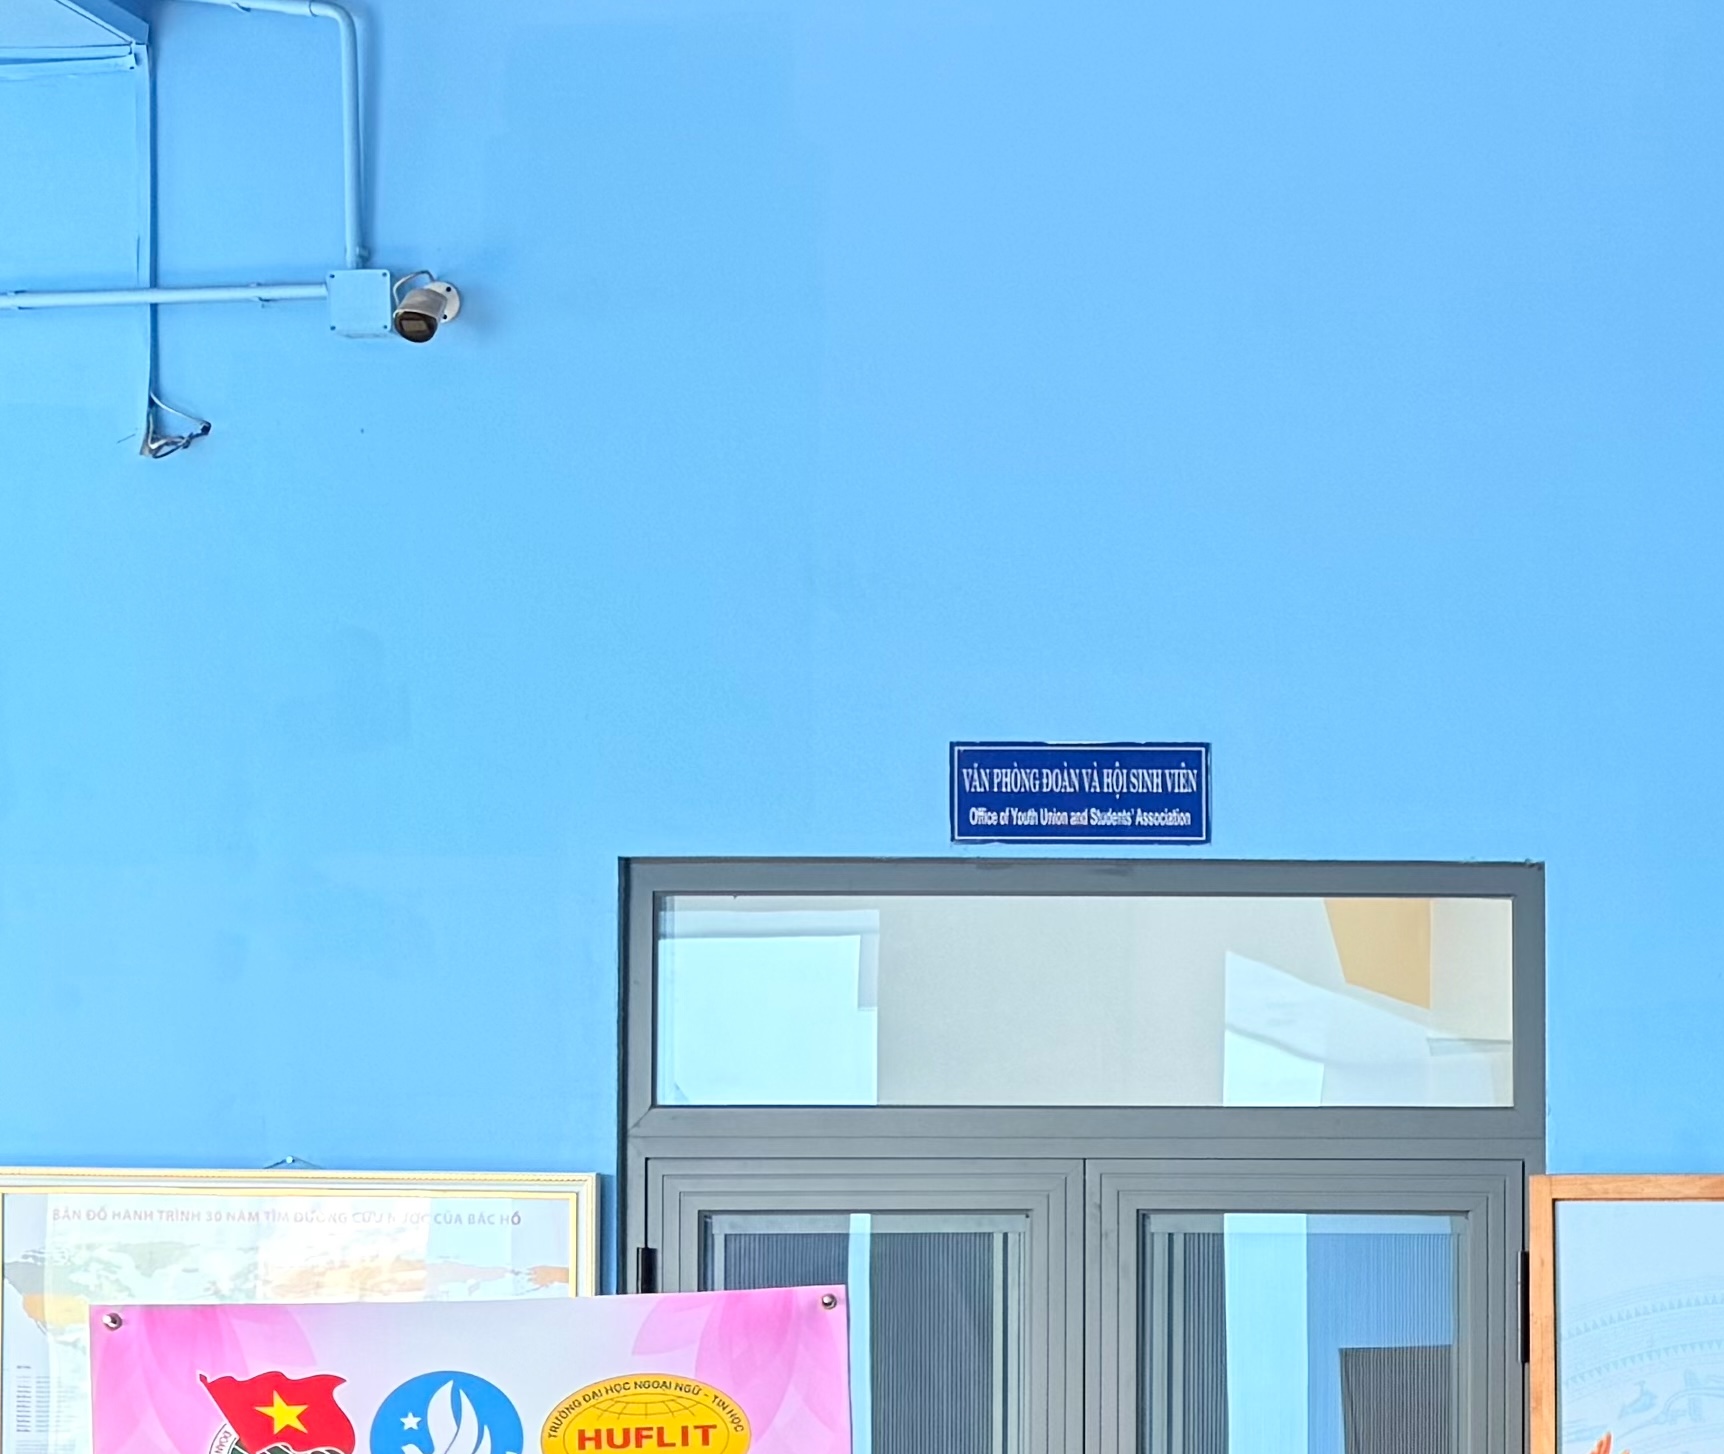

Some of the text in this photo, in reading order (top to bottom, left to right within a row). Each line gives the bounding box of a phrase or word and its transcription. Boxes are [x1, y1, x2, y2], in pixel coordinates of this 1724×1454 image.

[963, 762, 1197, 799] VĂN PHÒNG ĐOÀN VÀ HỘI SINH VIÊN
[969, 808, 998, 825] Office
[1000, 808, 1010, 825] of
[1011, 808, 1038, 825] Youth
[1040, 808, 1068, 825] Union
[1070, 808, 1088, 825] and
[1136, 808, 1191, 826] Association
[578, 1425, 717, 1450] HUFLIT
